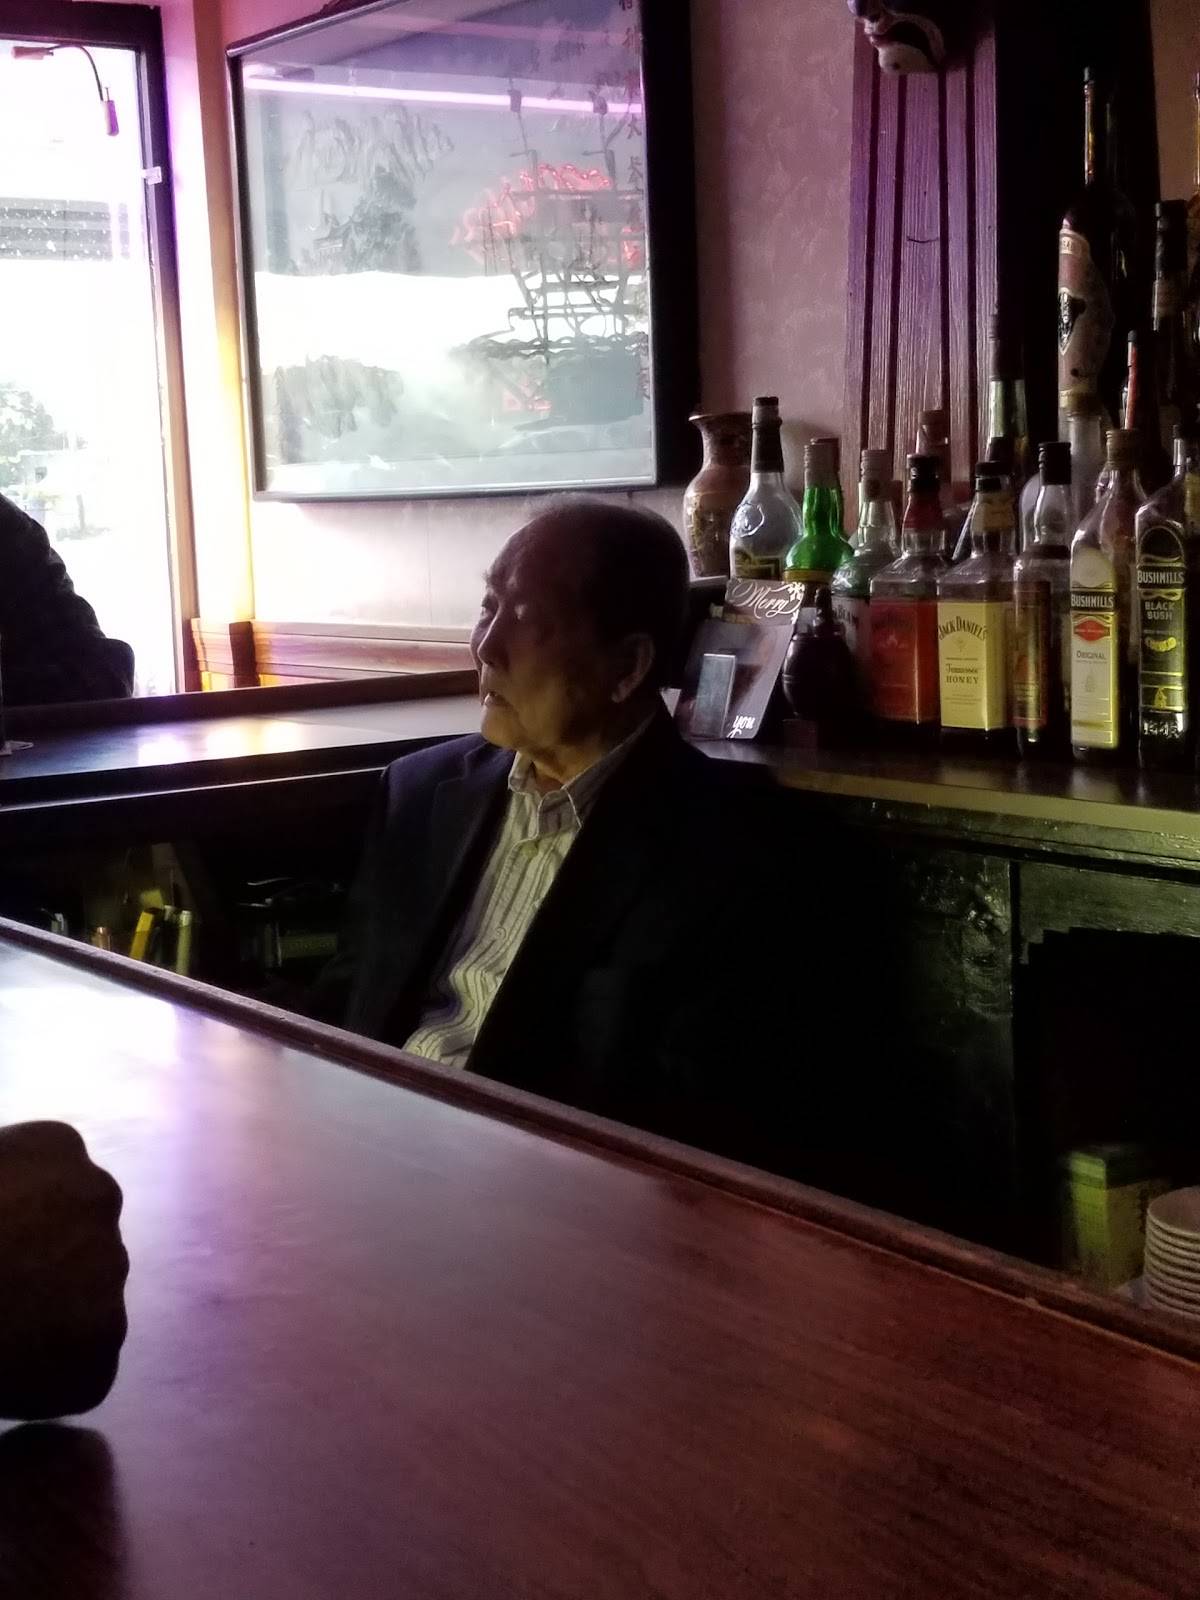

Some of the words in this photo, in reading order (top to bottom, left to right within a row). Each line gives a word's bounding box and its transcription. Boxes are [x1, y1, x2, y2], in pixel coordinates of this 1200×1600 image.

[1137, 570, 1184, 584] BUSHMILLS
[733, 581, 799, 620] Merry
[1071, 594, 1114, 608] BUSHMILLS
[1144, 601, 1175, 611] BLACK
[1147, 611, 1173, 620] BUSH
[946, 675, 979, 685] HONEY
[727, 715, 756, 739] you
